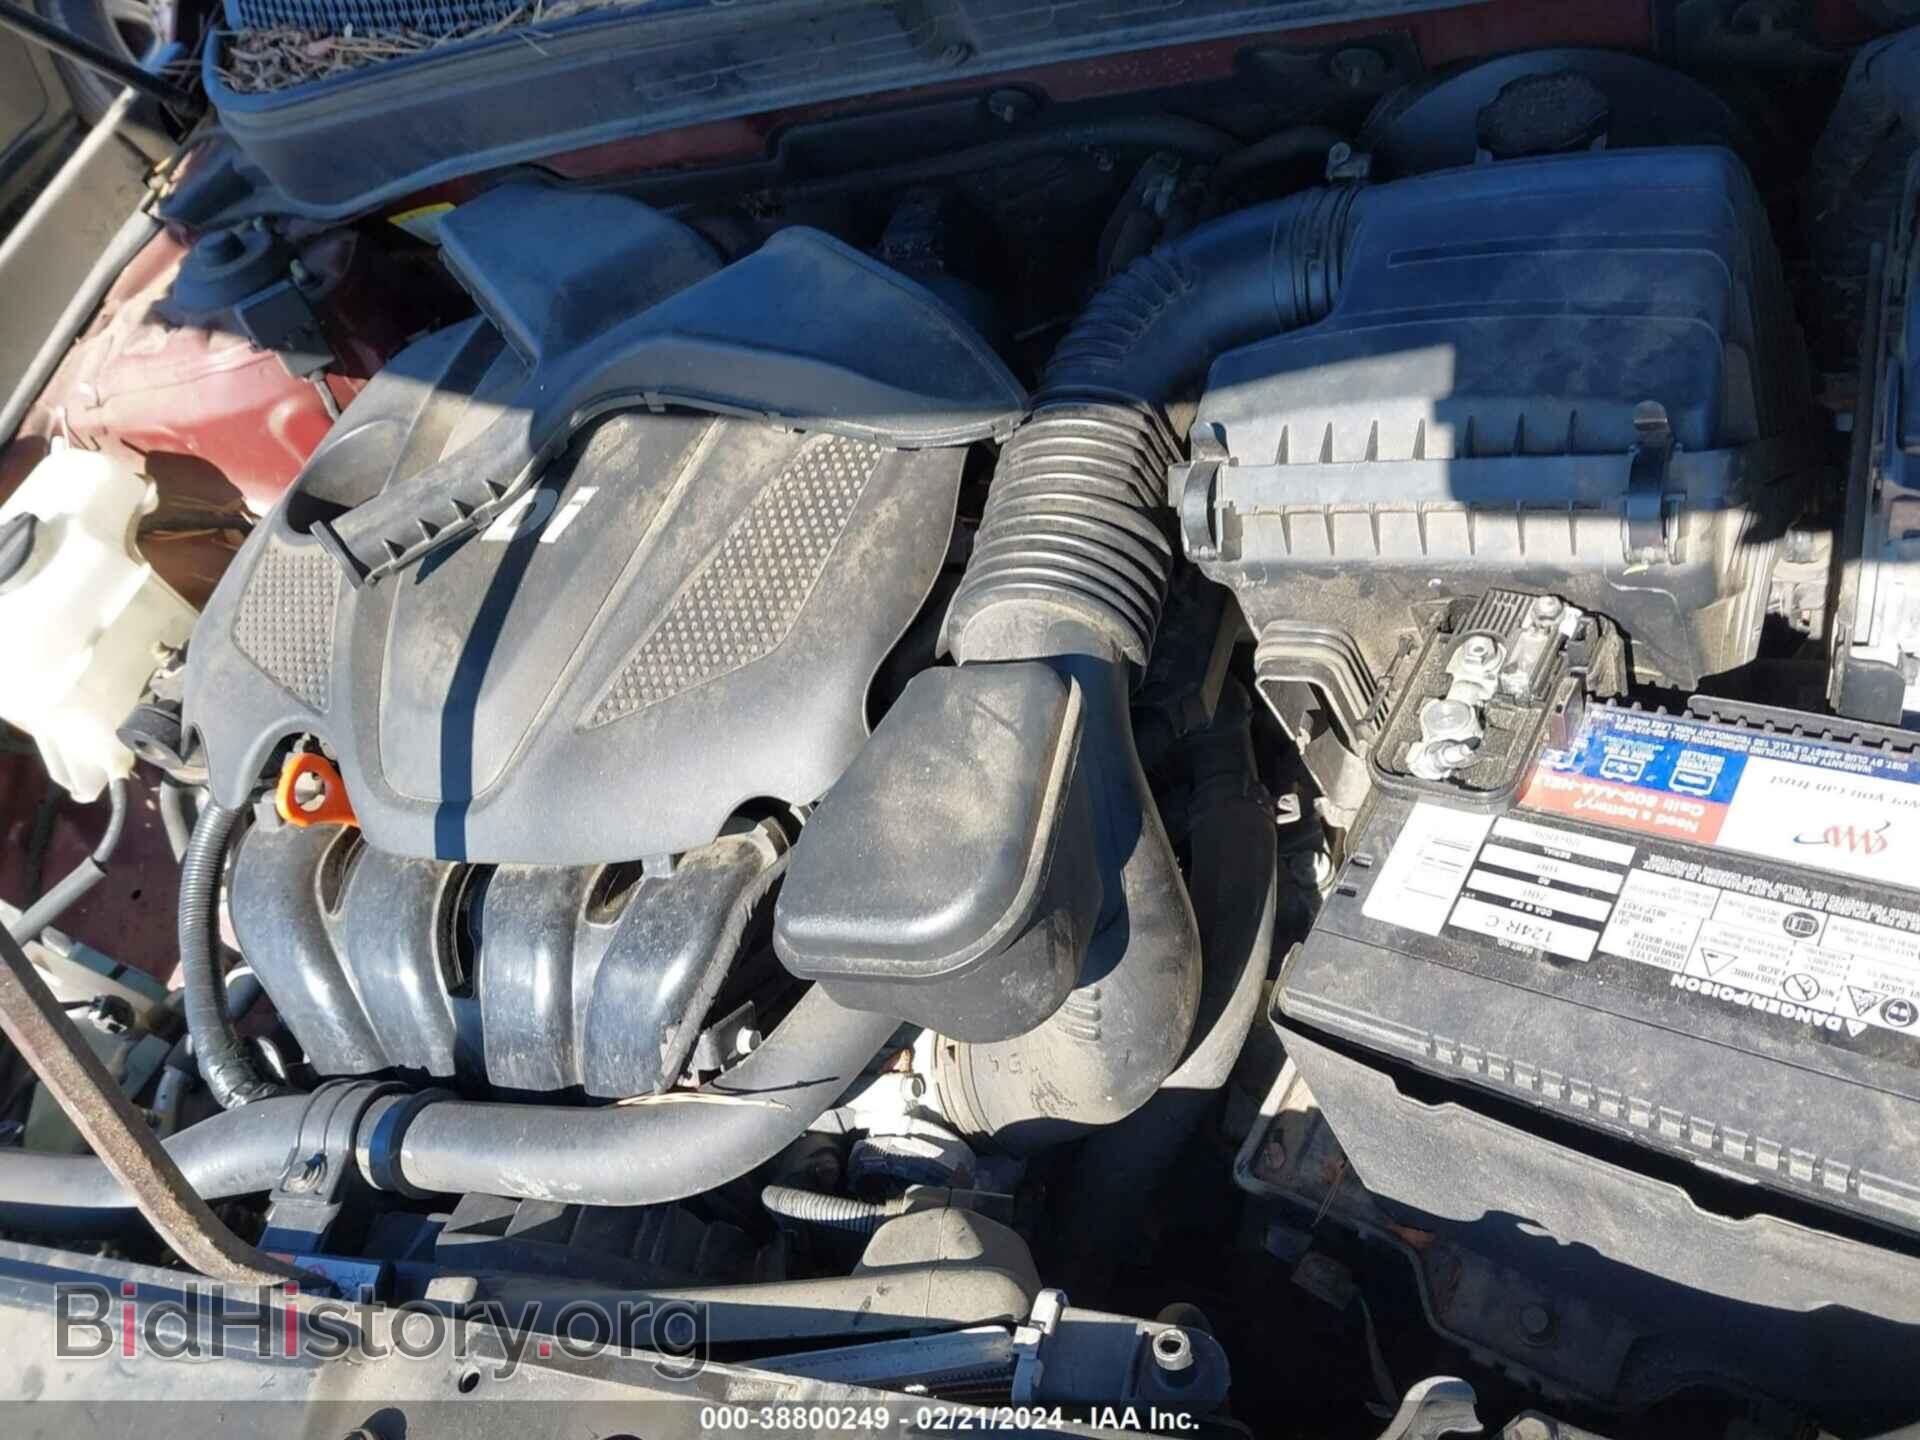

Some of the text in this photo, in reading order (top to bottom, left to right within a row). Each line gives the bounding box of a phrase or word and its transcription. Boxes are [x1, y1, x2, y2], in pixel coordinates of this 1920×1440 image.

[1696, 726, 1751, 744] TECHNOLOGY
[1748, 744, 1797, 761] RECYCLING
[1797, 753, 1818, 765] AND
[1843, 752, 1867, 765] CLUB
[1818, 756, 1872, 775] WARRANTY
[1869, 756, 1882, 767] BY
[1572, 795, 1699, 833] Need a battery?
[1542, 845, 1571, 859] SERIAL
[1669, 973, 1843, 1031] DANGER/POISON
